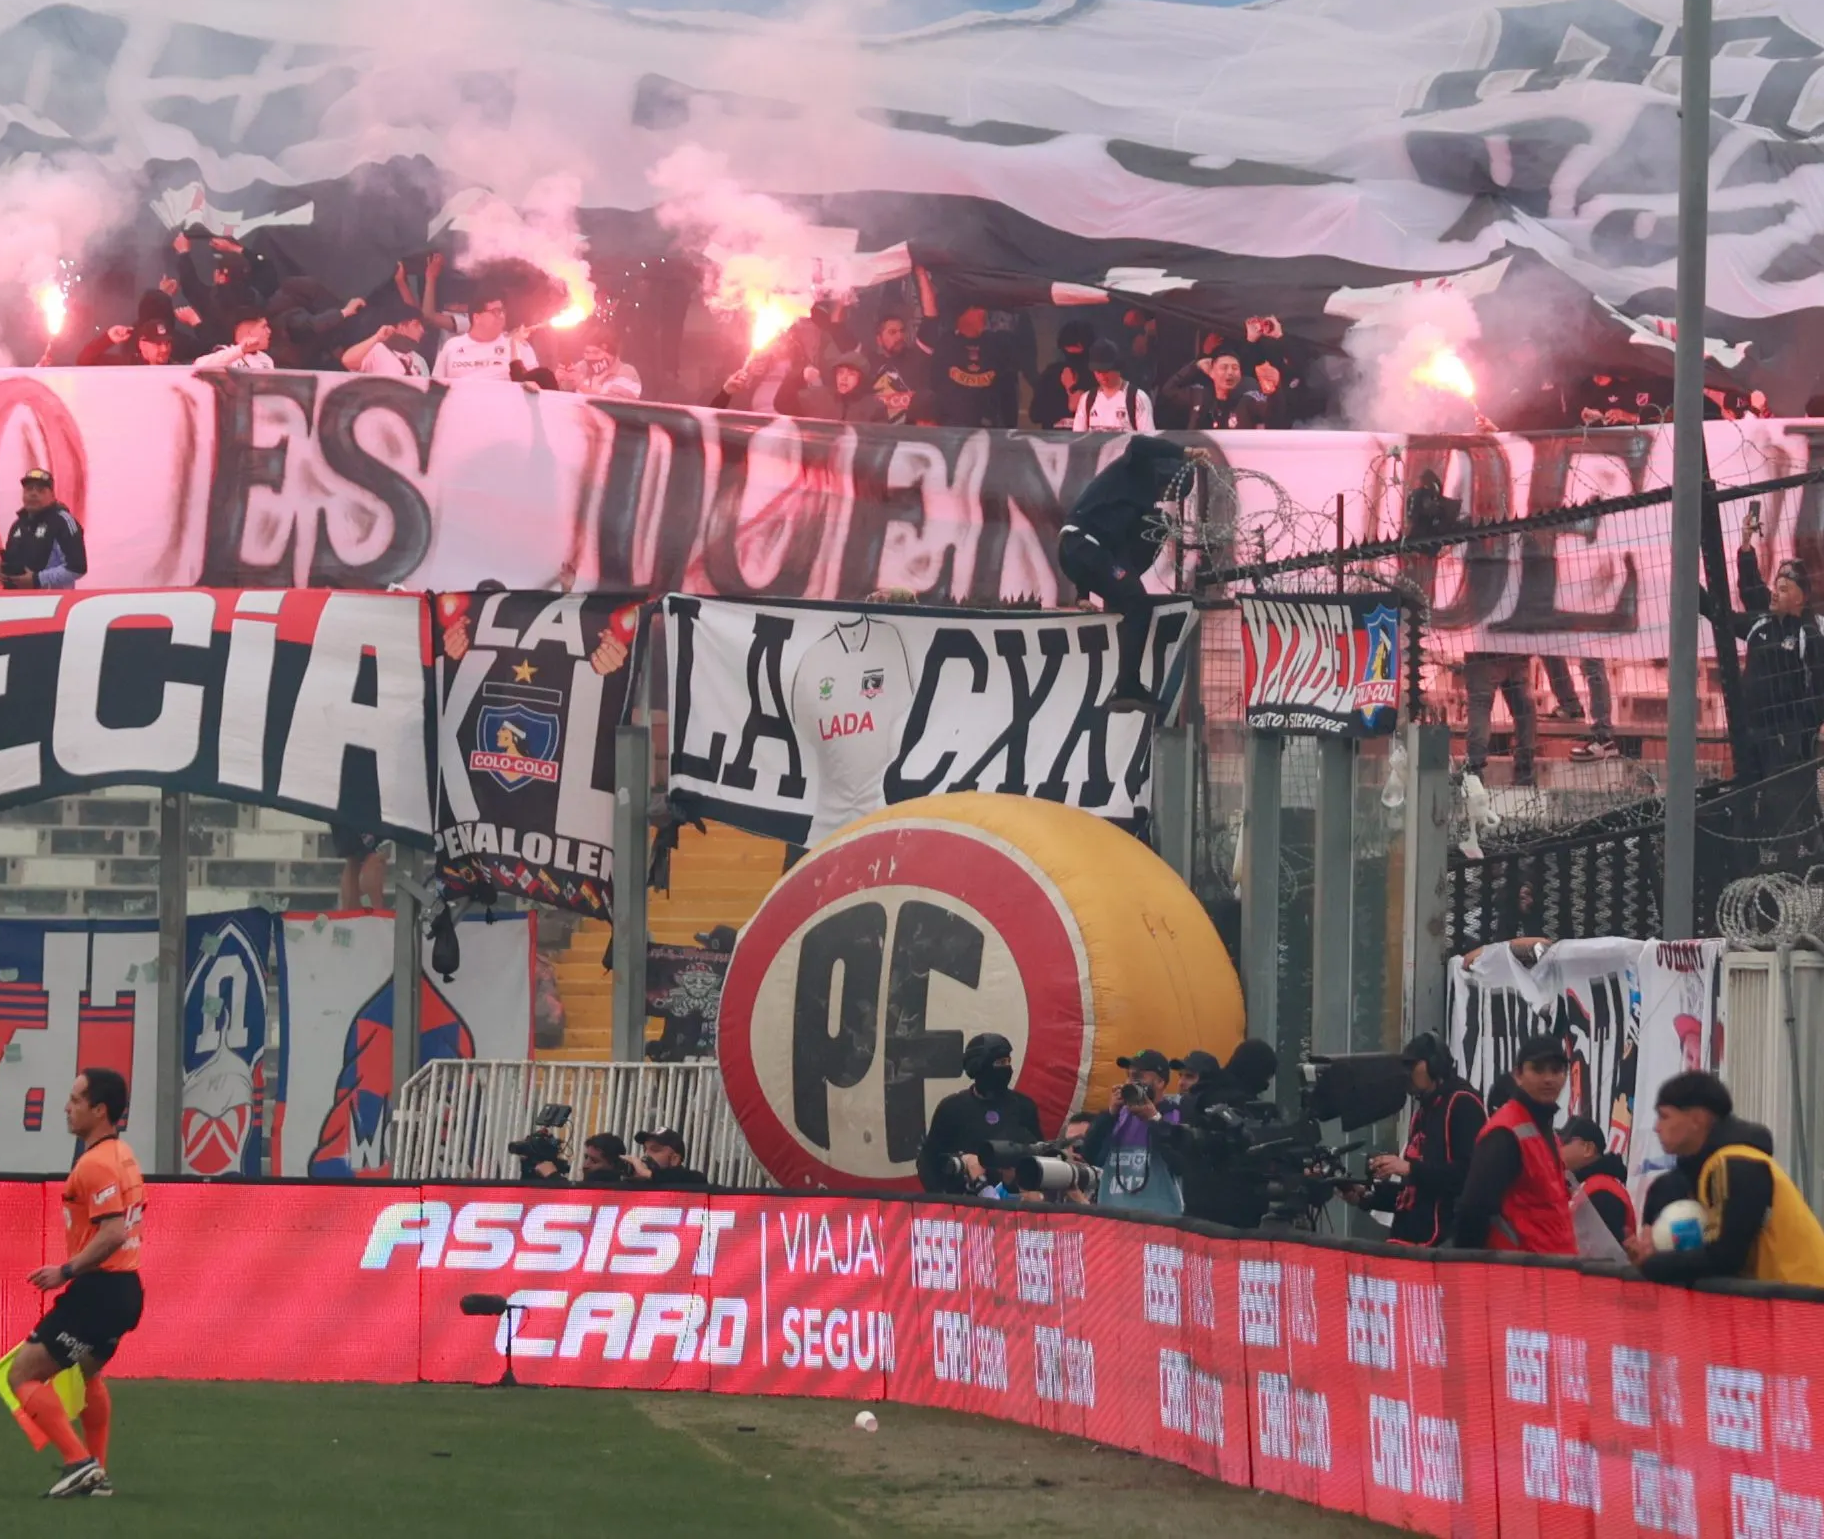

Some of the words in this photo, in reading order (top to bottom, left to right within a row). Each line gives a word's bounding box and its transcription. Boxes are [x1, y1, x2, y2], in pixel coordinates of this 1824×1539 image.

[474, 592, 588, 658] LA
[668, 596, 808, 801] LA
[818, 710, 875, 742] LADA
[793, 899, 987, 1165] PF
[359, 1201, 736, 1277] ASSIST
[494, 1289, 749, 1366] CARD
